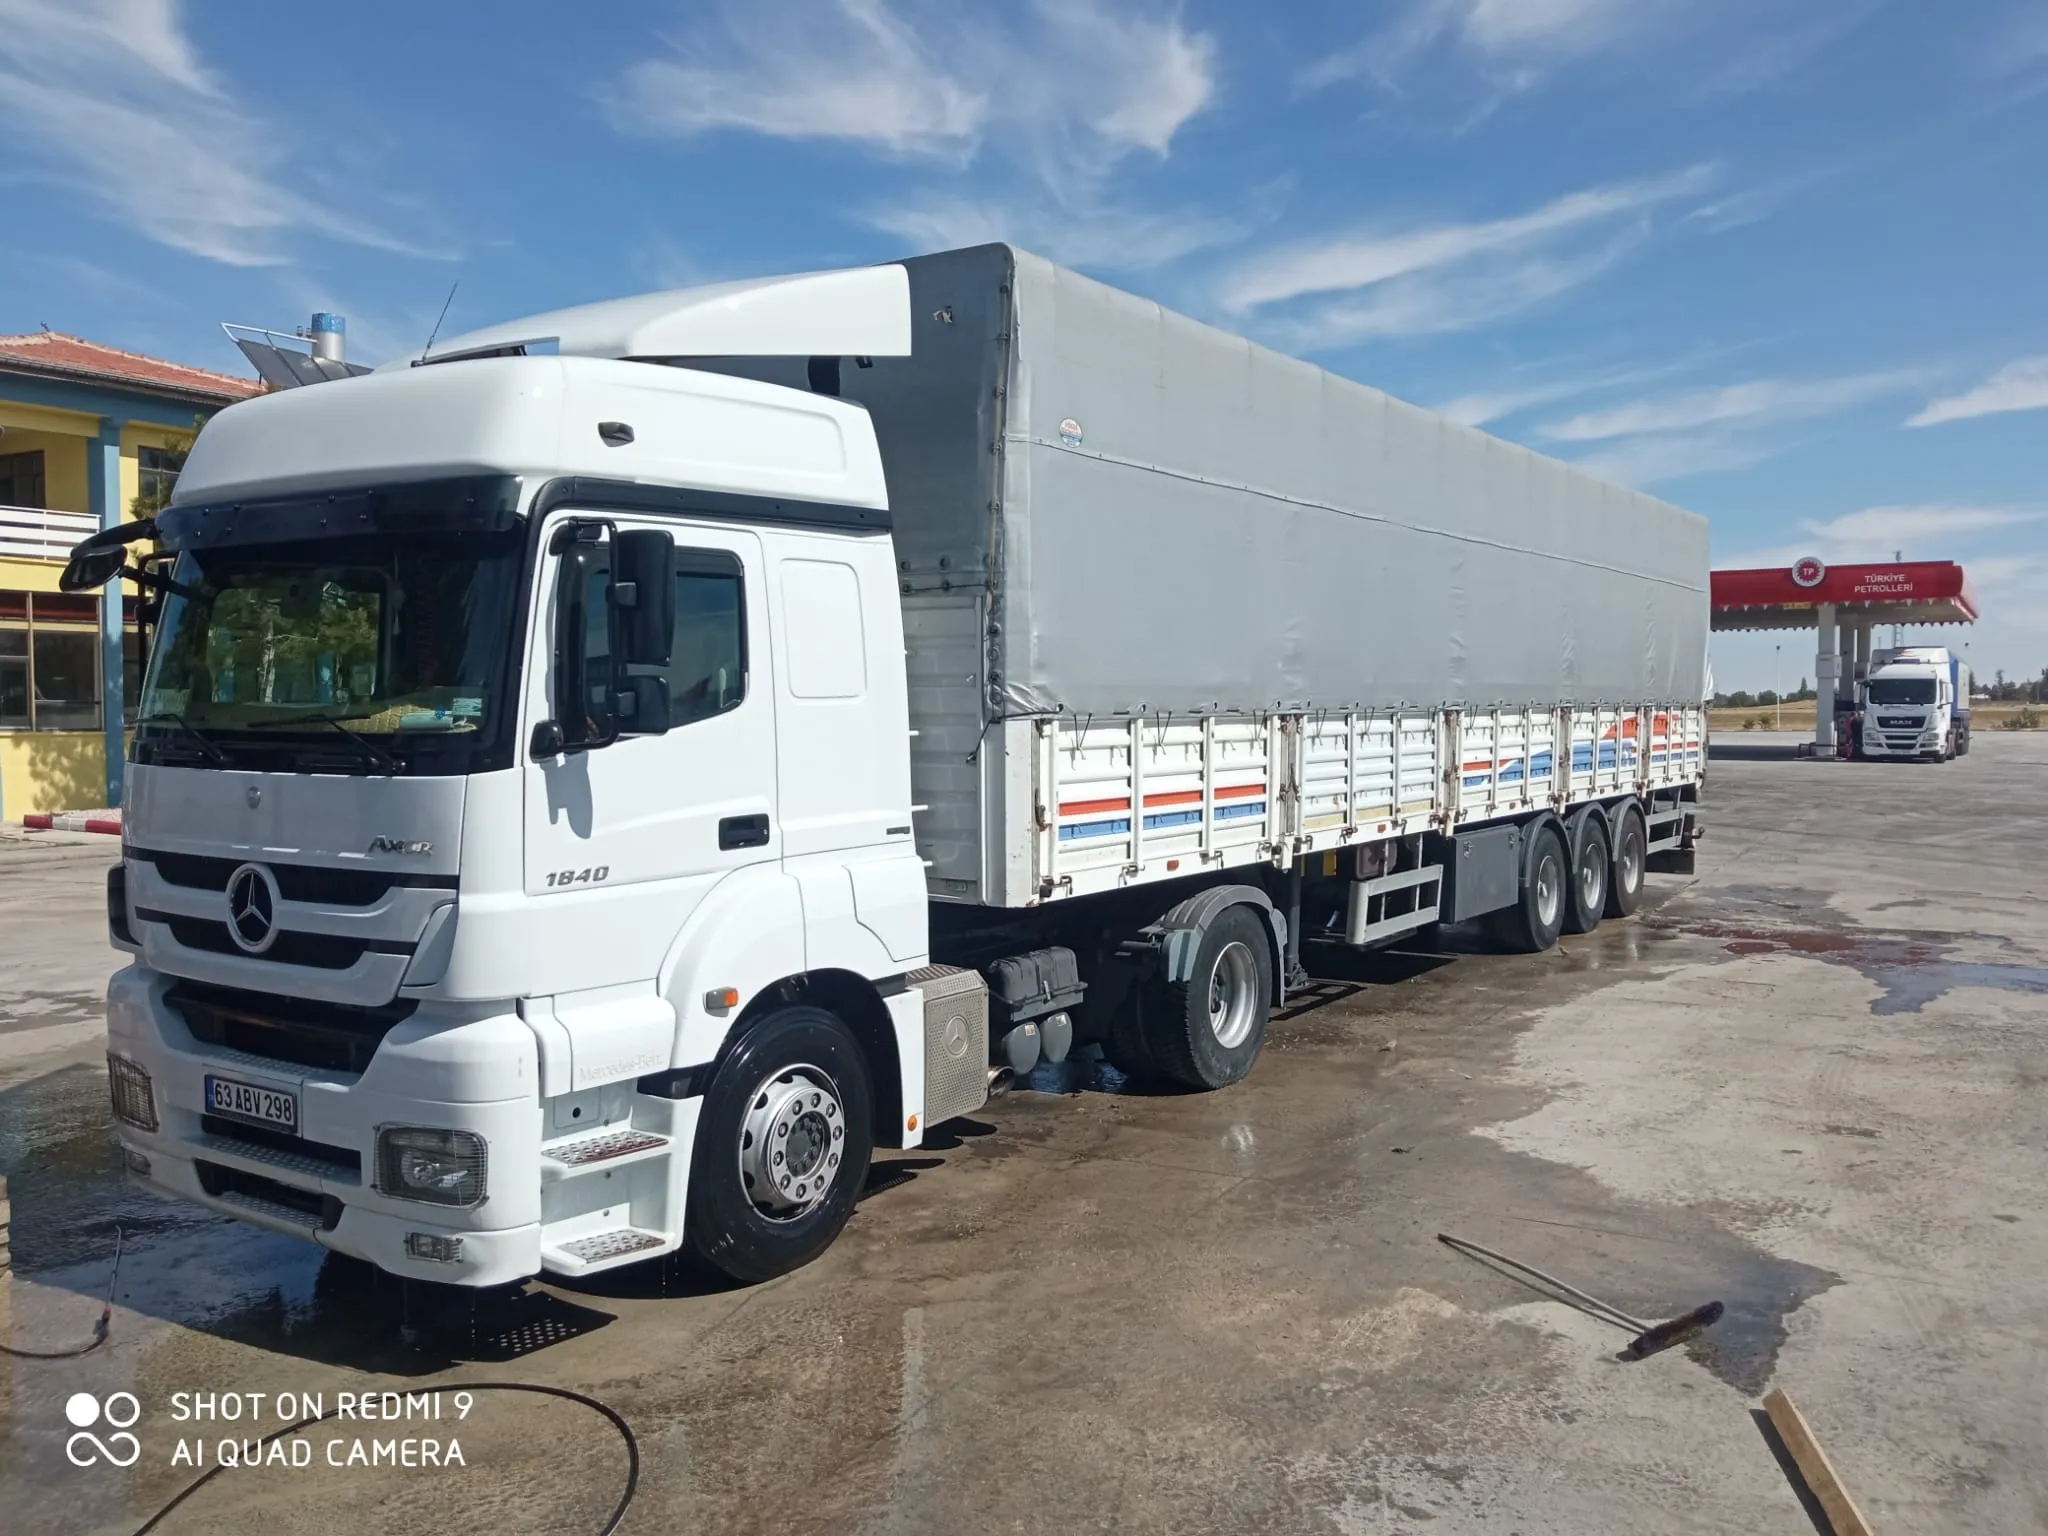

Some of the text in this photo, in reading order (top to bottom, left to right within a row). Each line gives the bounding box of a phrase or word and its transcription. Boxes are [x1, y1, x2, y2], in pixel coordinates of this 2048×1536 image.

[1864, 573, 1905, 582] TÜRKİYE
[1854, 583, 1913, 593] PETROLLERİ
[545, 865, 609, 887] 1840
[215, 1083, 292, 1122] 63 ABV 298
